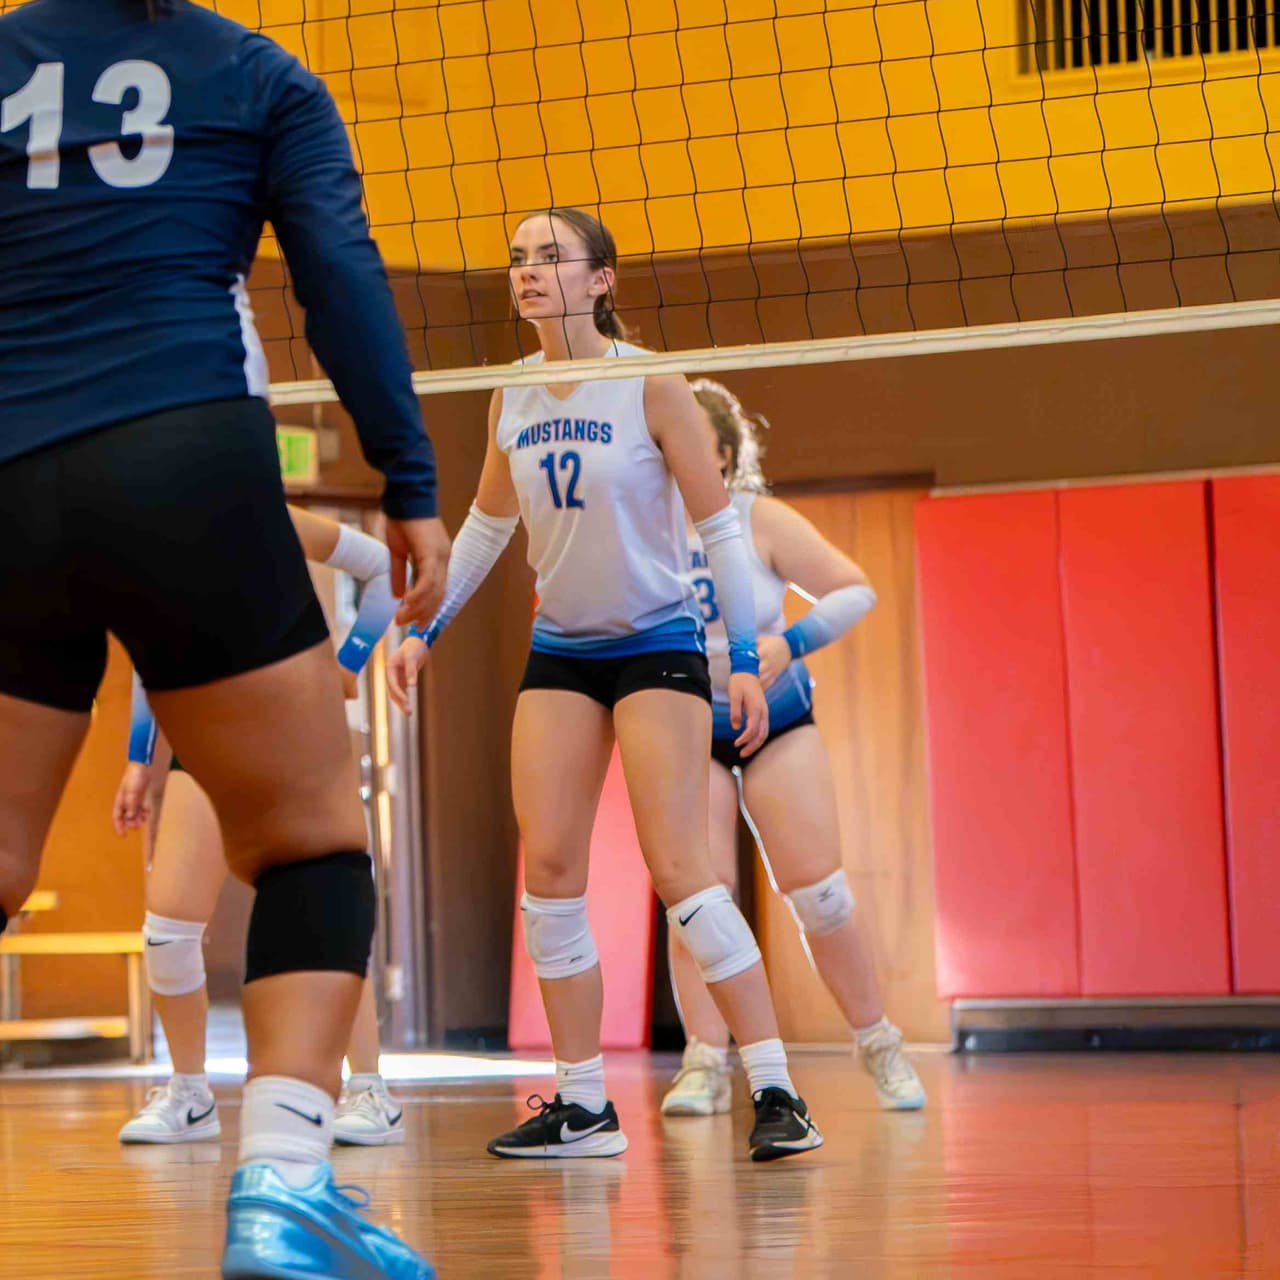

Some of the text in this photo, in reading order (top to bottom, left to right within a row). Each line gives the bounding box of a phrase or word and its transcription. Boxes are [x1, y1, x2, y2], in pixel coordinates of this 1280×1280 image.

[1, 59, 175, 190] 13
[516, 418, 613, 449] MUSTANGS
[539, 451, 585, 510] 12
